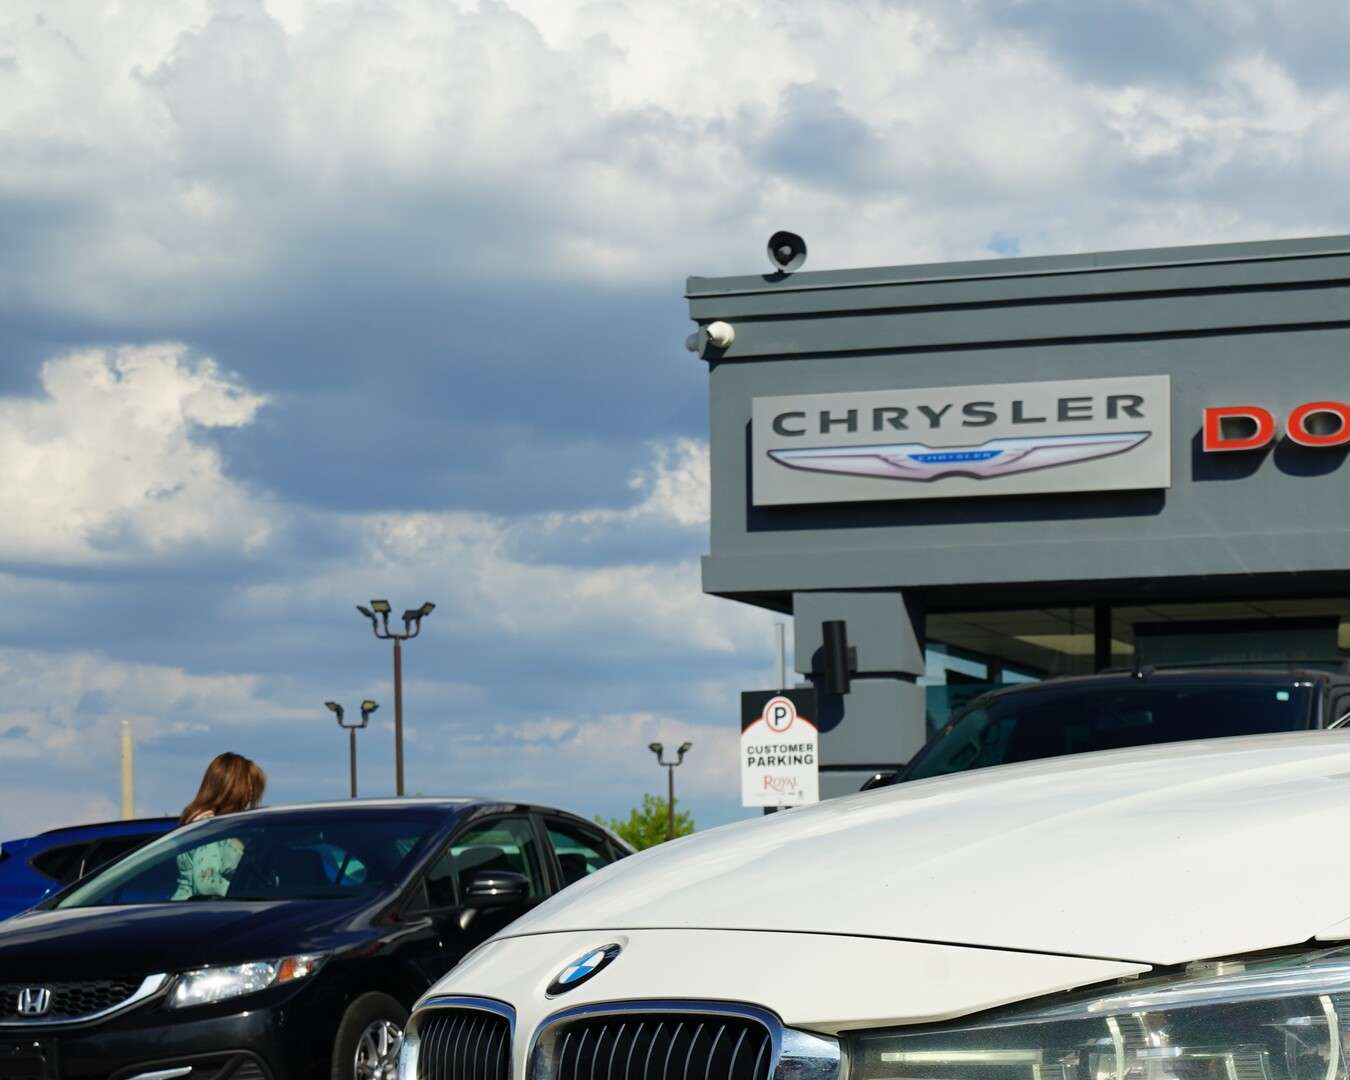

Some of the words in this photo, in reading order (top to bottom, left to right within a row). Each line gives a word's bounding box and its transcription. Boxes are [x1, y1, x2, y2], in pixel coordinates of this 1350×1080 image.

[772, 394, 1145, 438] CHRYSLER
[774, 706, 786, 726] P
[747, 743, 814, 754] CUSTOMER
[747, 754, 814, 767] PARKING
